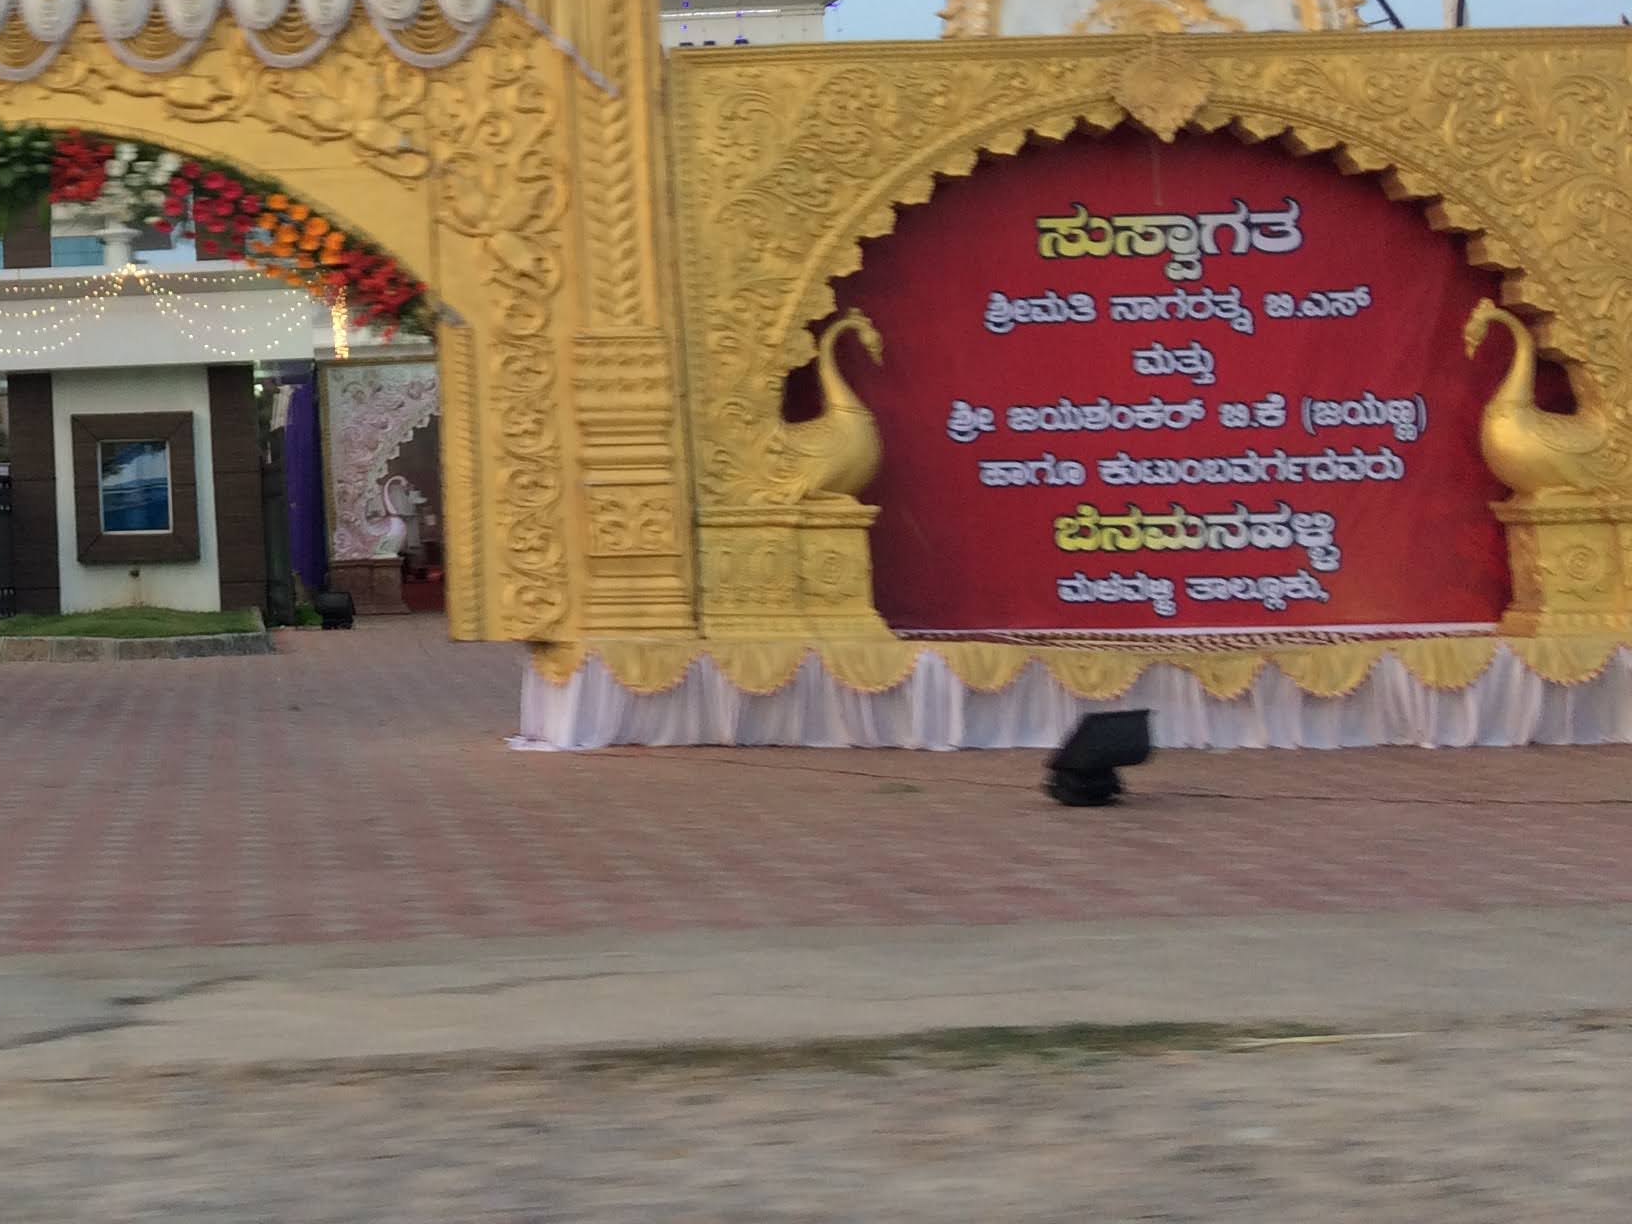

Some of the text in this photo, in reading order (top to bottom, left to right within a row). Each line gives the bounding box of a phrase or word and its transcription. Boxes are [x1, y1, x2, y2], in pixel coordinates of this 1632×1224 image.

[1036, 198, 1303, 282] ಸುಸ್ವಾಗತ
[984, 290, 1098, 334] ಶ್ರೀಮತಿ
[1132, 341, 1216, 386] ಮತ್ತು
[946, 400, 997, 443] ಶ್ರೀ
